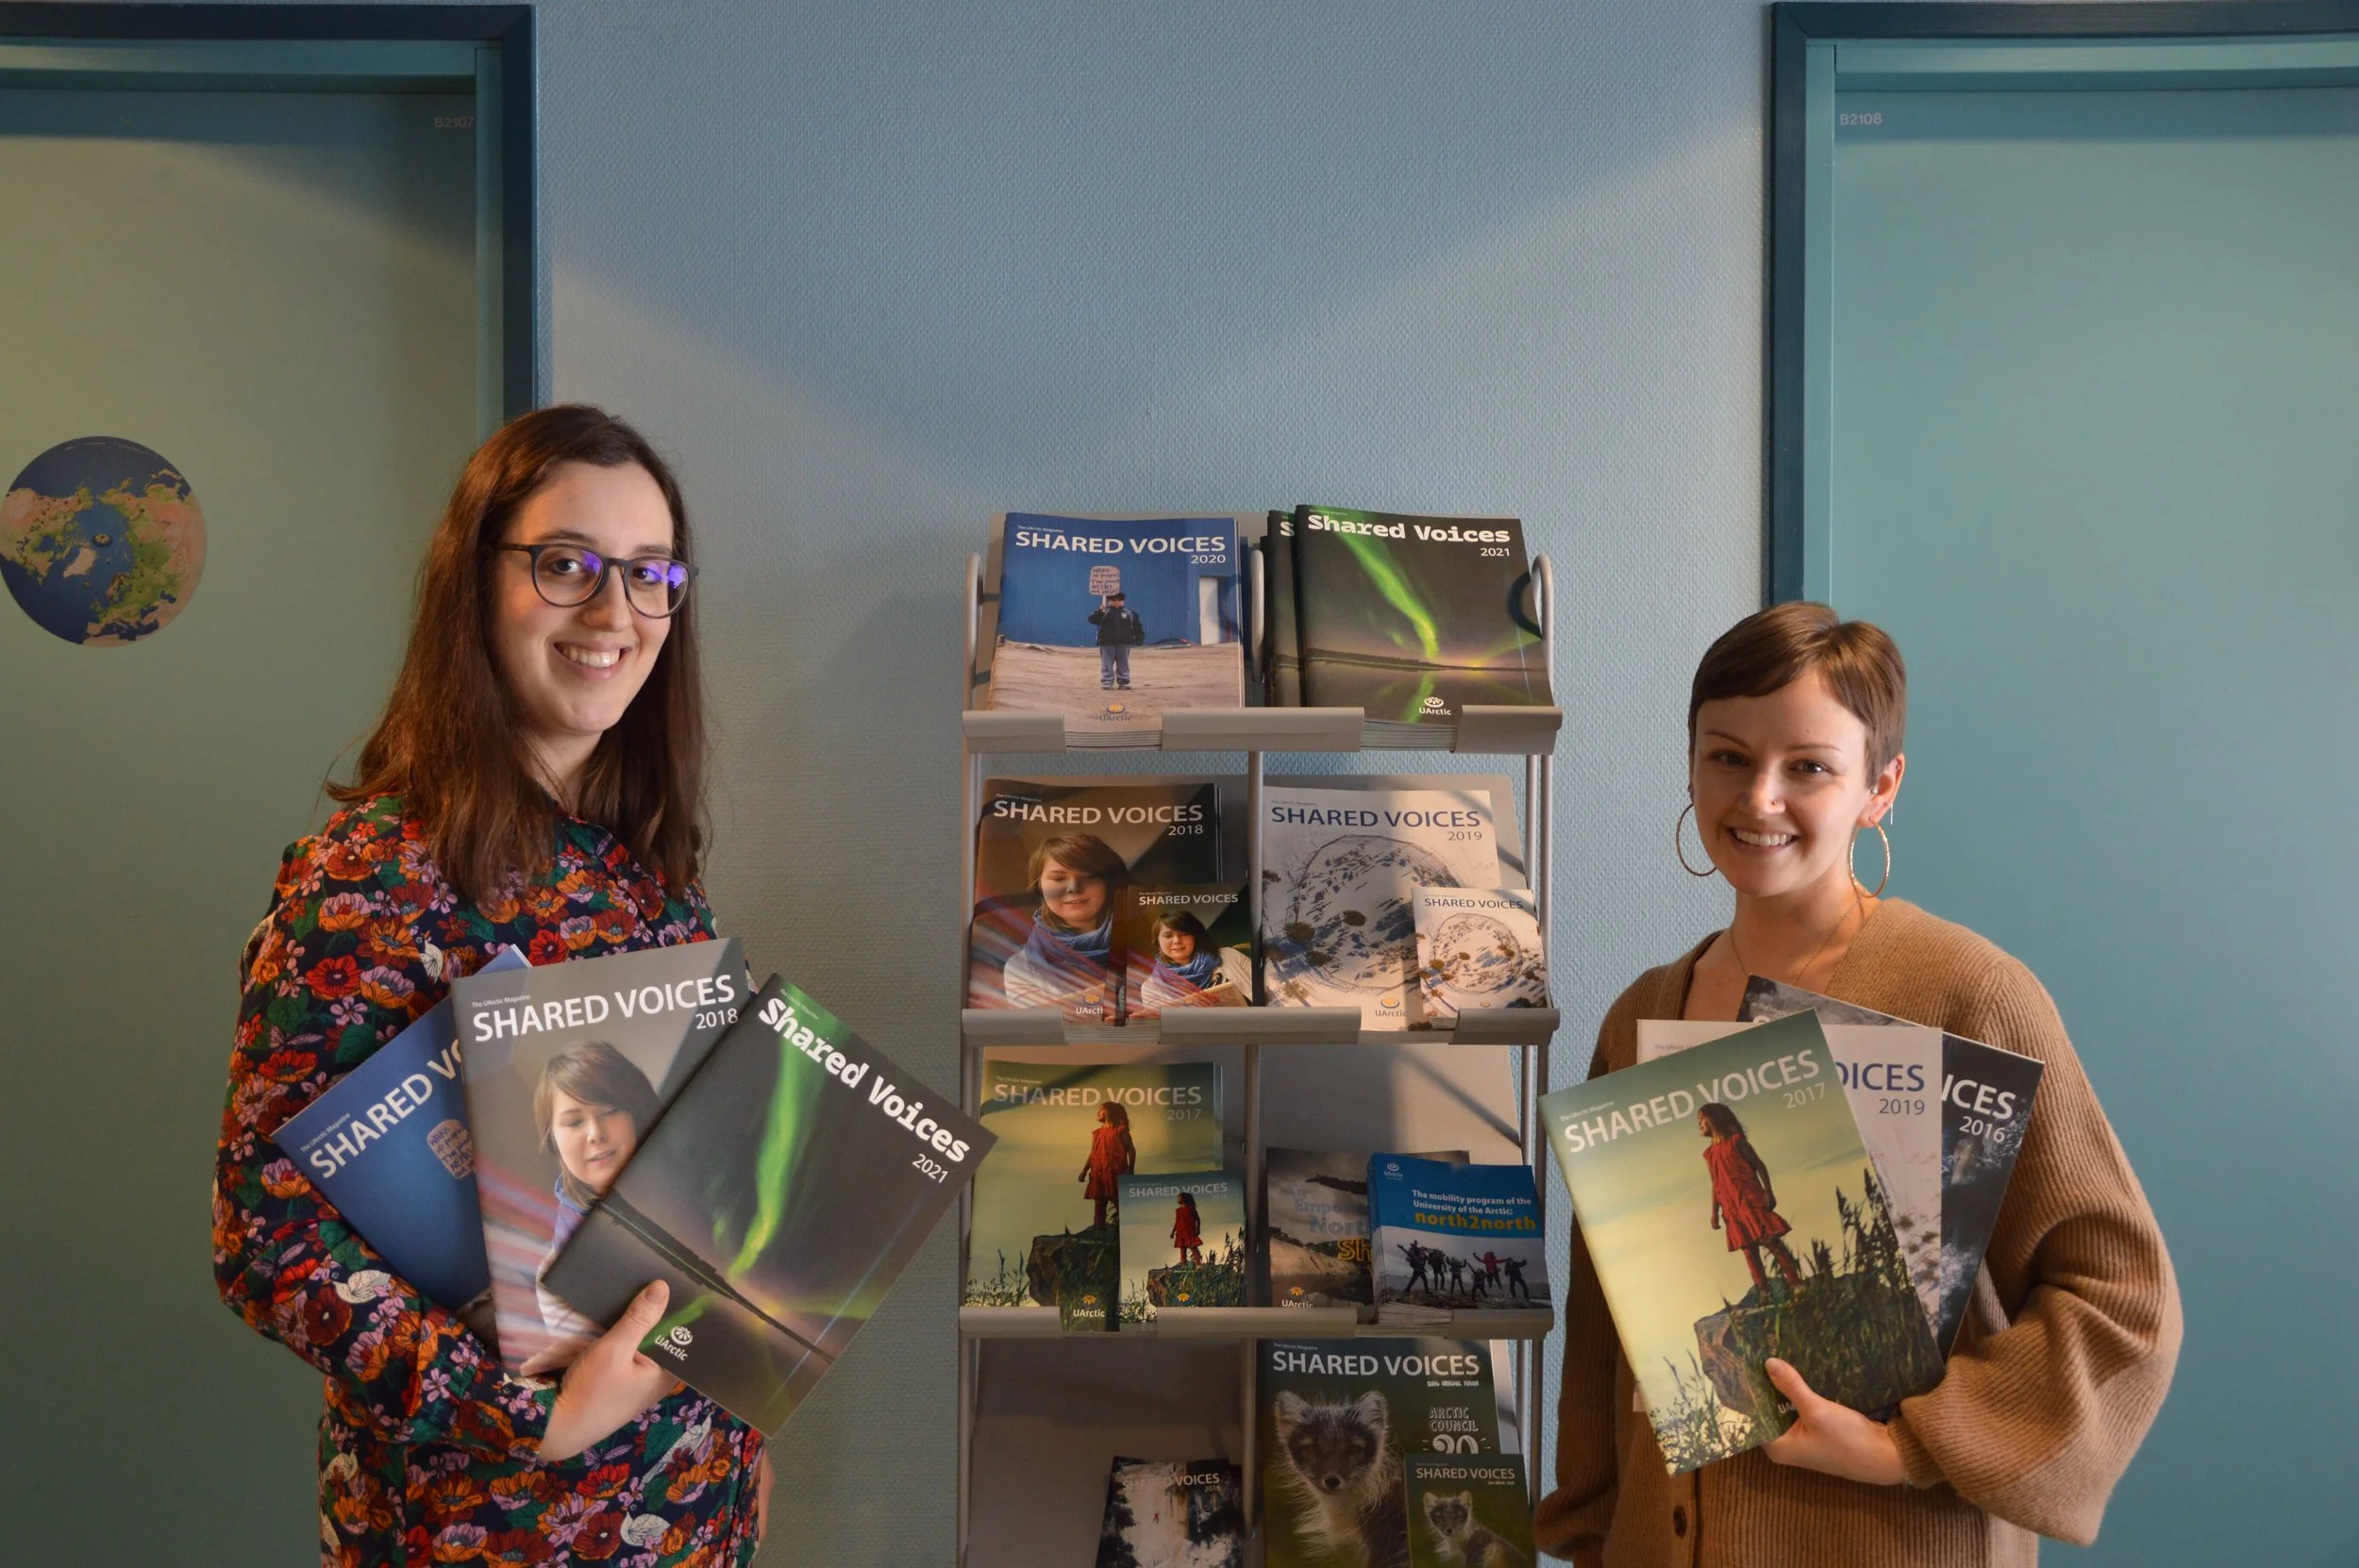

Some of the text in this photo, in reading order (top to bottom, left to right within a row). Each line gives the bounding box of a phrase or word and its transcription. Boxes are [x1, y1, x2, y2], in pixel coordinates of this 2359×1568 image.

[434, 116, 475, 128] B2107
[1840, 113, 1882, 125] B2108
[1308, 514, 1405, 539] Shared
[1414, 525, 1510, 542] Voices
[1015, 531, 1226, 554] SHARED VOICES
[1191, 554, 1226, 564] 2020
[1481, 547, 1510, 557] 2021
[1419, 707, 1451, 715] UArctic
[994, 800, 1203, 824] SHARED VOICES
[1272, 807, 1481, 827] SHARED VOICES
[1168, 826, 1203, 836] 2018
[1447, 831, 1482, 841] 2019
[1139, 894, 1239, 906] SHARED VOICES
[1425, 898, 1523, 909] SHARED VOICES
[504, 994, 530, 1004] Magazine
[473, 975, 735, 1042] SHARED VOICES
[695, 1008, 738, 1029] 2018
[759, 998, 970, 1162] Shared Voices
[994, 1084, 1202, 1107] SHARED VOICES
[1564, 1049, 1819, 1153] SHARED VOICES
[1783, 1082, 1825, 1109] 2017
[1941, 1074, 2016, 1120] ICES
[1167, 1109, 1201, 1120] 2017
[1879, 1099, 1925, 1115] 2019
[310, 1074, 433, 1178] SHARED
[1959, 1116, 2005, 1143] 2016
[912, 1154, 948, 1183] 2021
[1129, 1183, 1228, 1197] SHARED VOICES
[1412, 1190, 1428, 1198] The
[1430, 1193, 1465, 1205] mobility
[1466, 1197, 1504, 1206] program
[1505, 1196, 1515, 1205] of
[1413, 1200, 1457, 1212] University
[1458, 1204, 1468, 1213] of
[1468, 1206, 1483, 1214] the
[1415, 1212, 1536, 1231] north2north
[1073, 1309, 1106, 1317] UArctic
[655, 1334, 688, 1361] UArctic
[1273, 1351, 1481, 1376] SHARED VOICES
[1429, 1407, 1469, 1419] ARCTIC
[1430, 1420, 1479, 1432] COUNCIL
[1416, 1467, 1515, 1479] SHARED VOICES
[1122, 1473, 1220, 1490] SHARED VOICES
[1204, 1484, 1221, 1493] 2016
